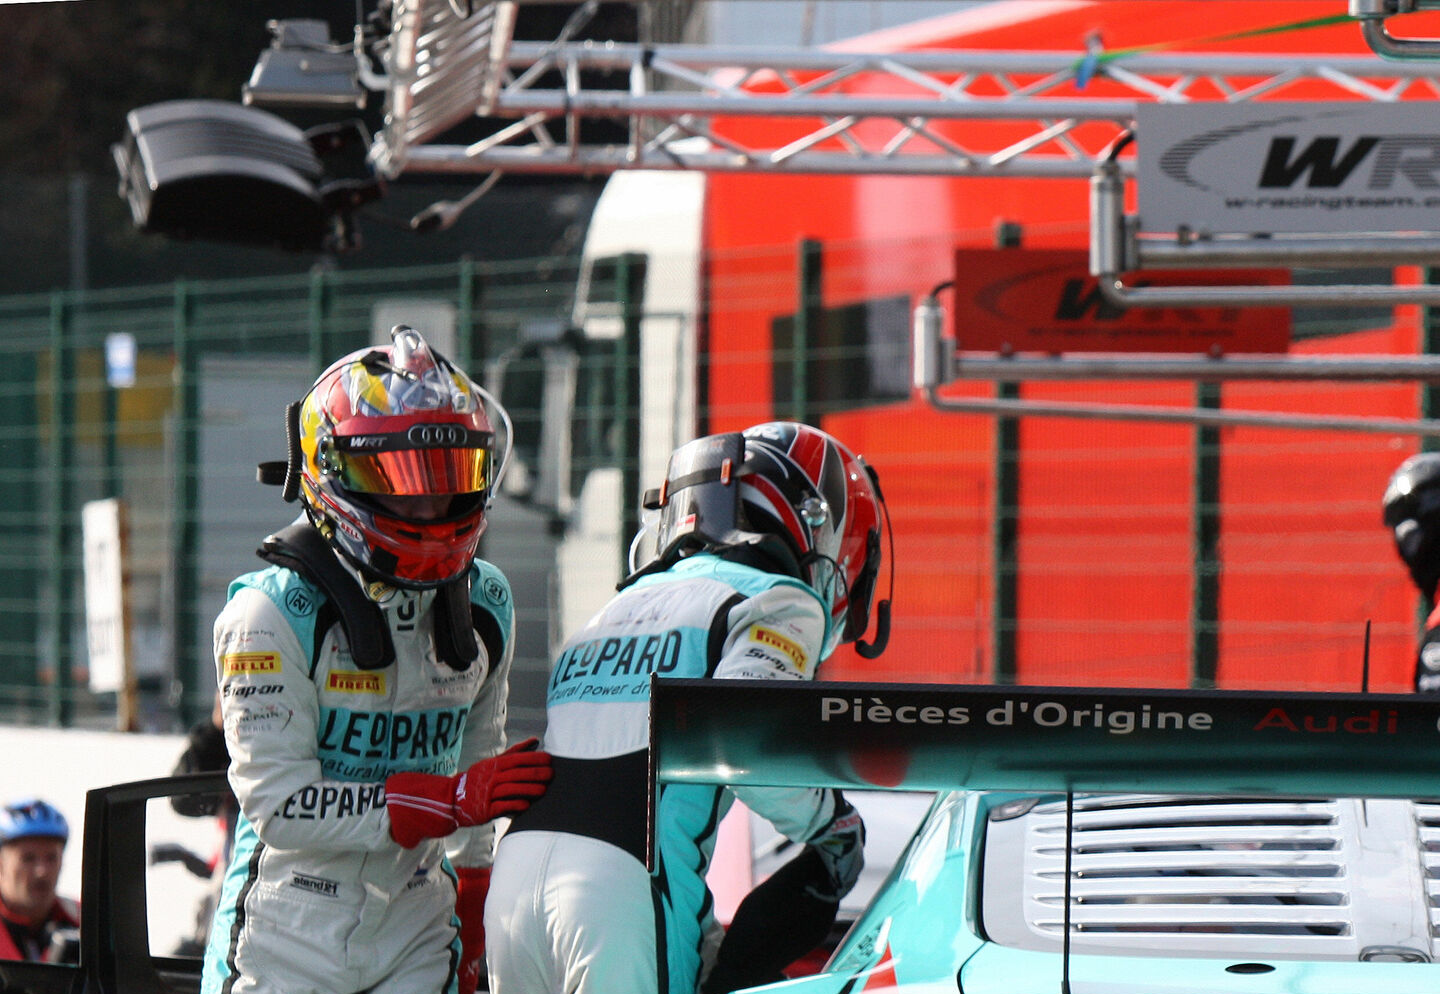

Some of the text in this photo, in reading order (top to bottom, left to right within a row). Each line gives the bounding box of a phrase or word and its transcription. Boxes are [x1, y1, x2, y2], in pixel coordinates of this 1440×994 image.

[350, 436, 388, 448] WRT
[340, 521, 360, 540] BELL
[225, 655, 275, 671] PRELLI
[552, 629, 682, 692] LEOPARD
[330, 673, 381, 692] PIRELLI
[580, 683, 629, 700] power
[820, 696, 971, 725] Pièces
[985, 700, 1215, 735] d'Origine
[1253, 707, 1399, 734] Audi
[274, 783, 386, 820] EOPARD
